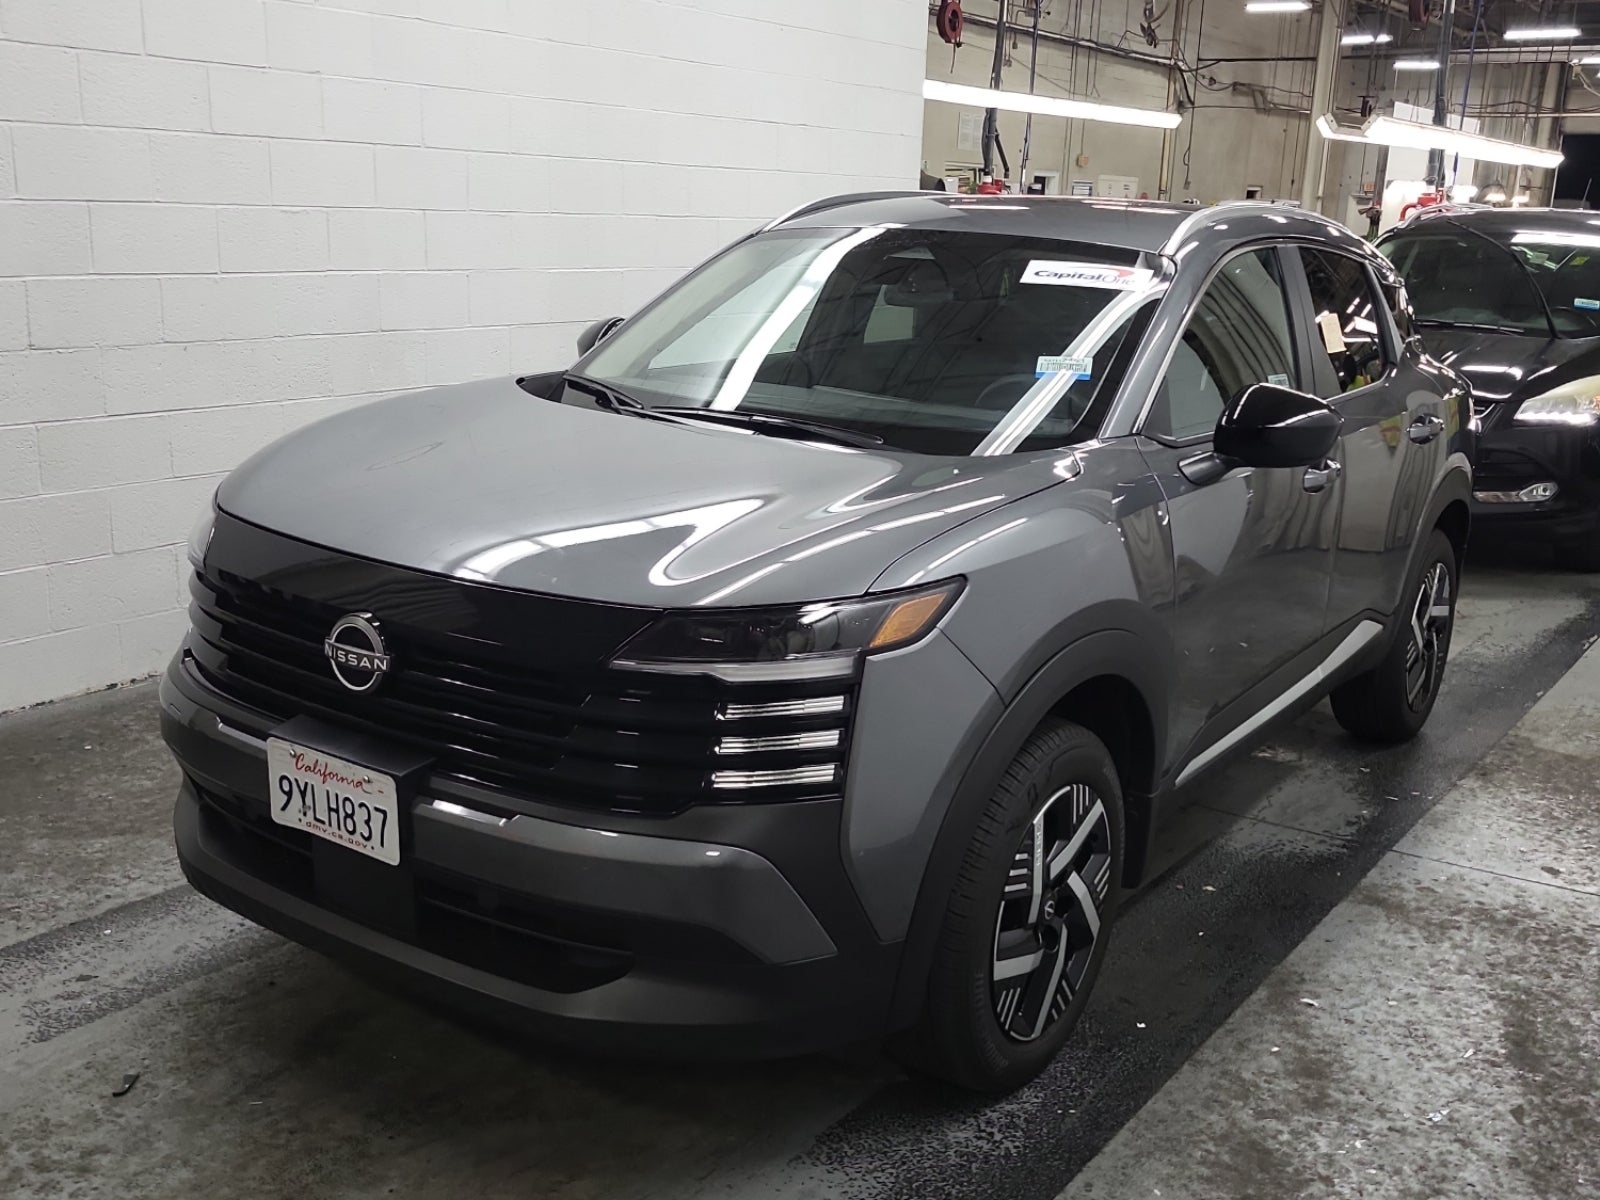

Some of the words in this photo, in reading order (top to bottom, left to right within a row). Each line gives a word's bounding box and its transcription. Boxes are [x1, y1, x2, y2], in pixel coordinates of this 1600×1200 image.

[325, 643, 387, 670] NISSAN
[295, 753, 372, 794] California
[279, 774, 387, 848] 9YLH837
[305, 821, 368, 848] dmv.ca.gov
